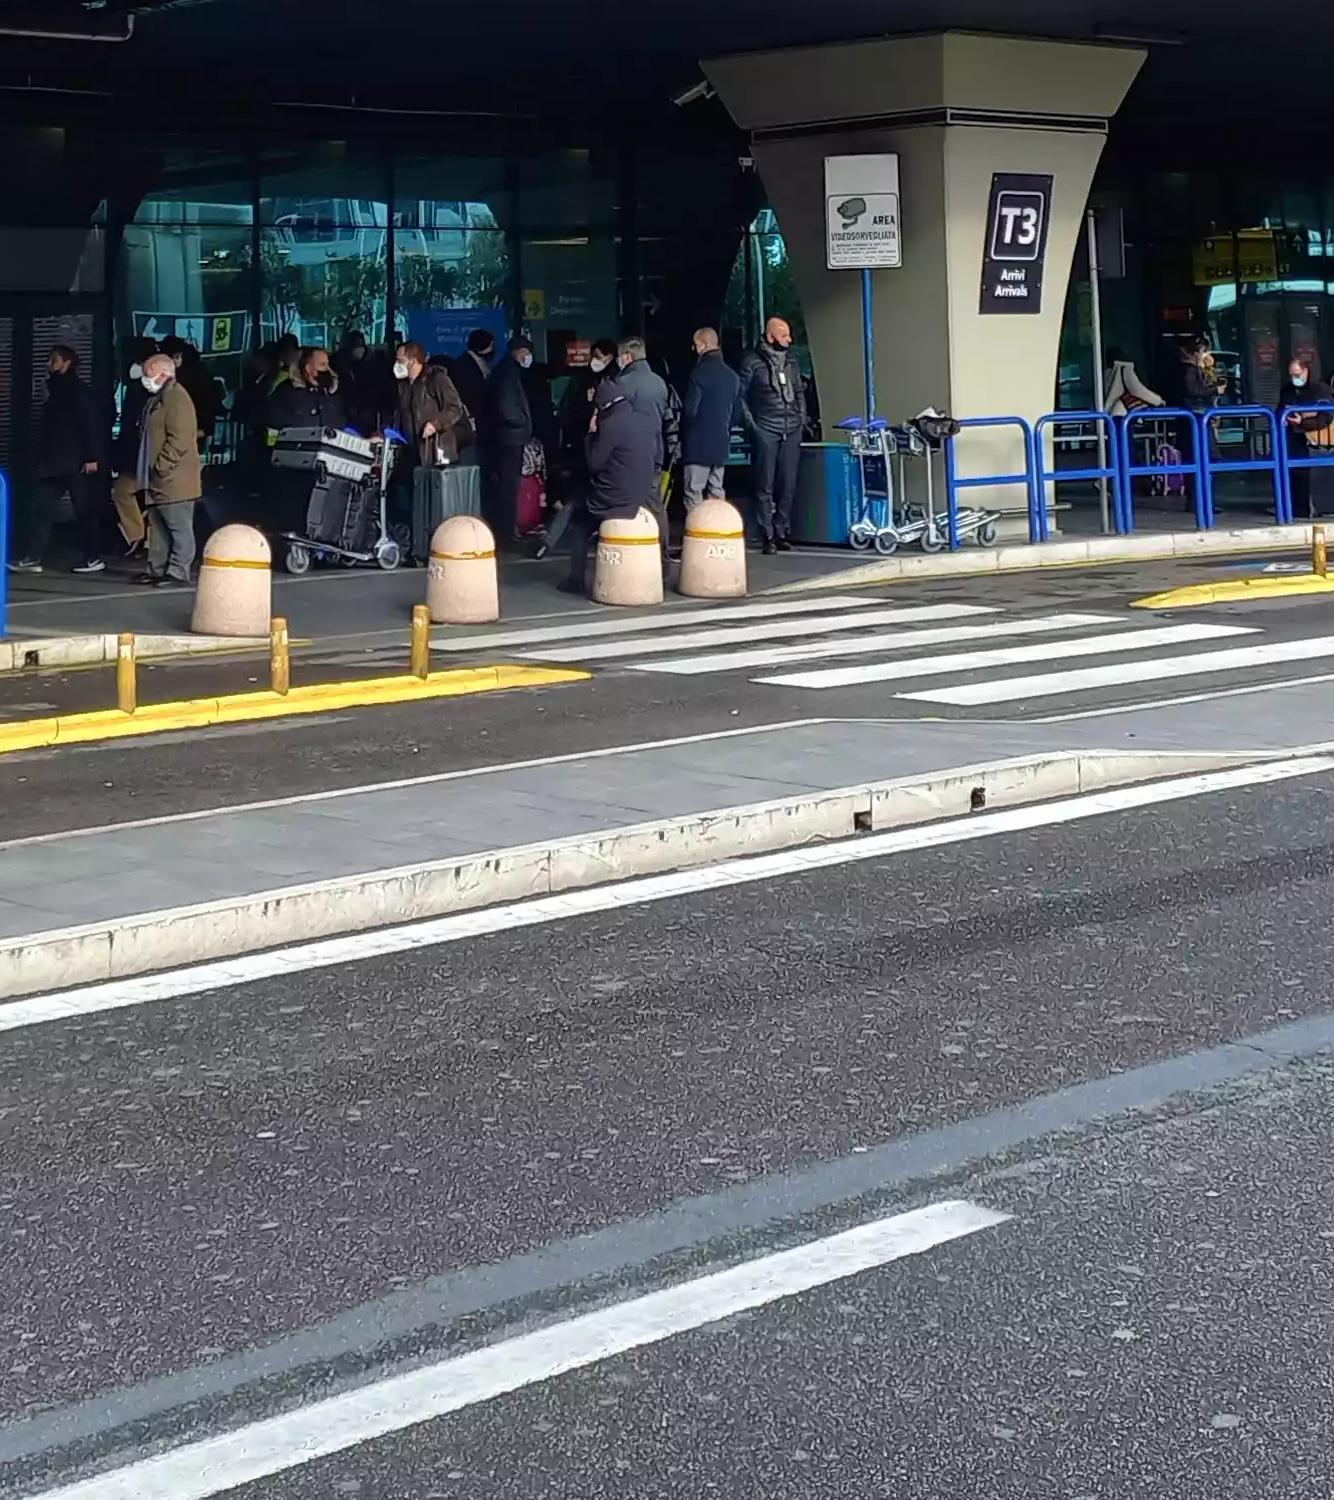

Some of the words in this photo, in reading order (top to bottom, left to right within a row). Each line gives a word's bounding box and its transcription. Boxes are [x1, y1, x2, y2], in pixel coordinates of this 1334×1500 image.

[872, 215, 896, 226] AREA
[1000, 207, 1038, 245] T3
[1000, 268, 1025, 282] Arrivi
[994, 285, 1028, 298] Arrivals
